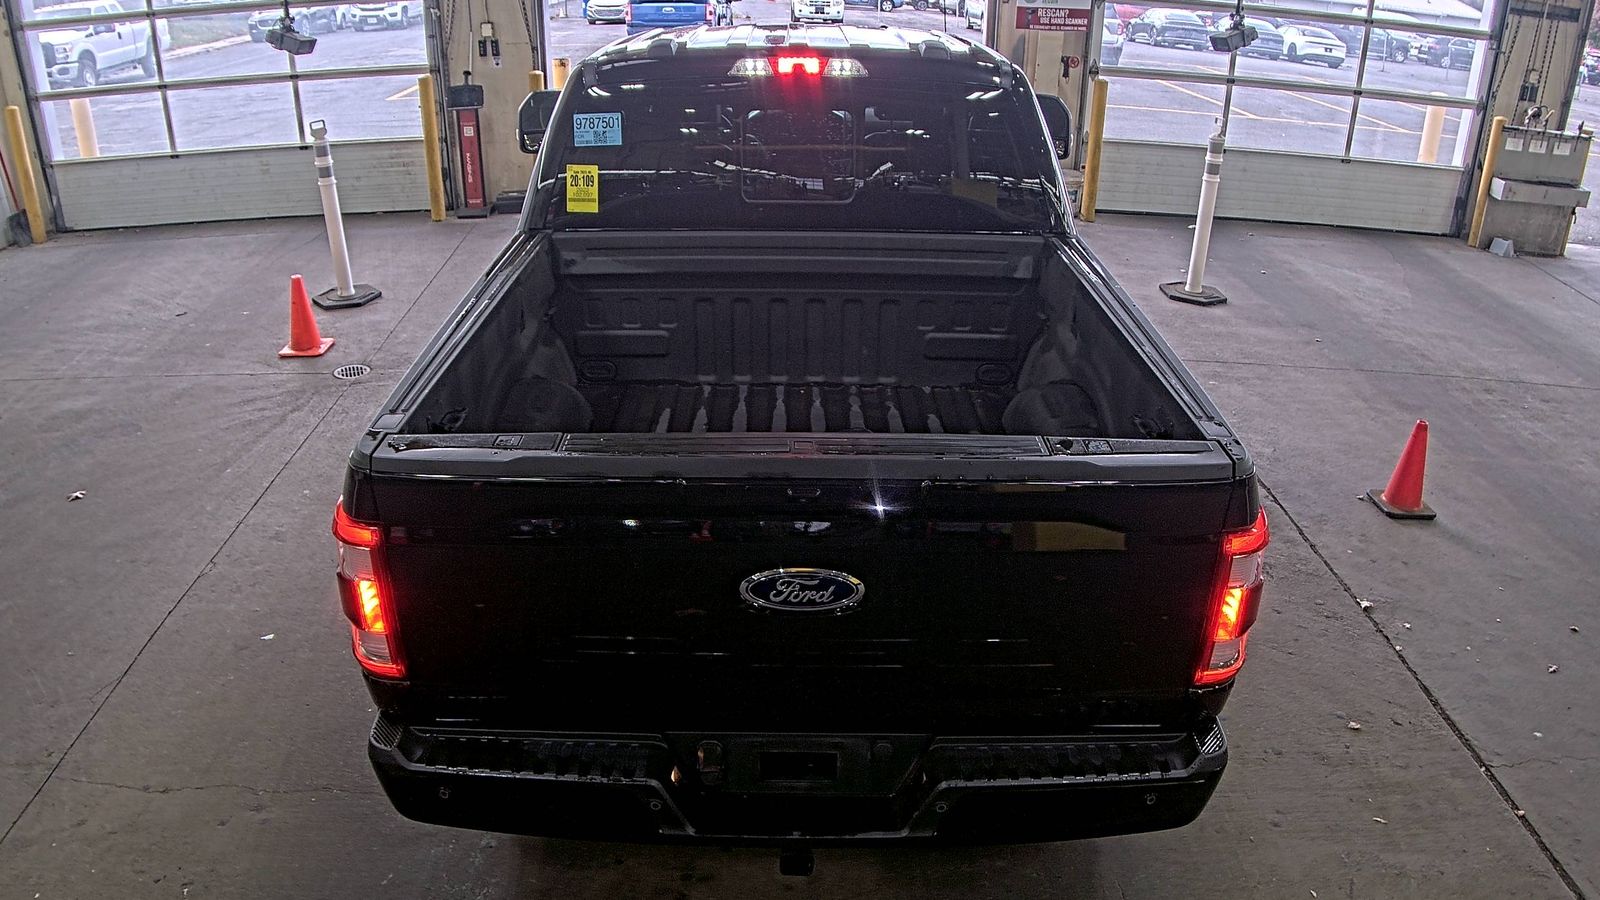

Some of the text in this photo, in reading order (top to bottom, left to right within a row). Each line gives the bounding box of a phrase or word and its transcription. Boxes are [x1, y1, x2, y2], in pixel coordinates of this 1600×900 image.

[1038, 8, 1069, 18] RESCAN?
[575, 116, 620, 130] 9787501
[570, 174, 595, 187] 20:109
[769, 578, 834, 603] Ford
